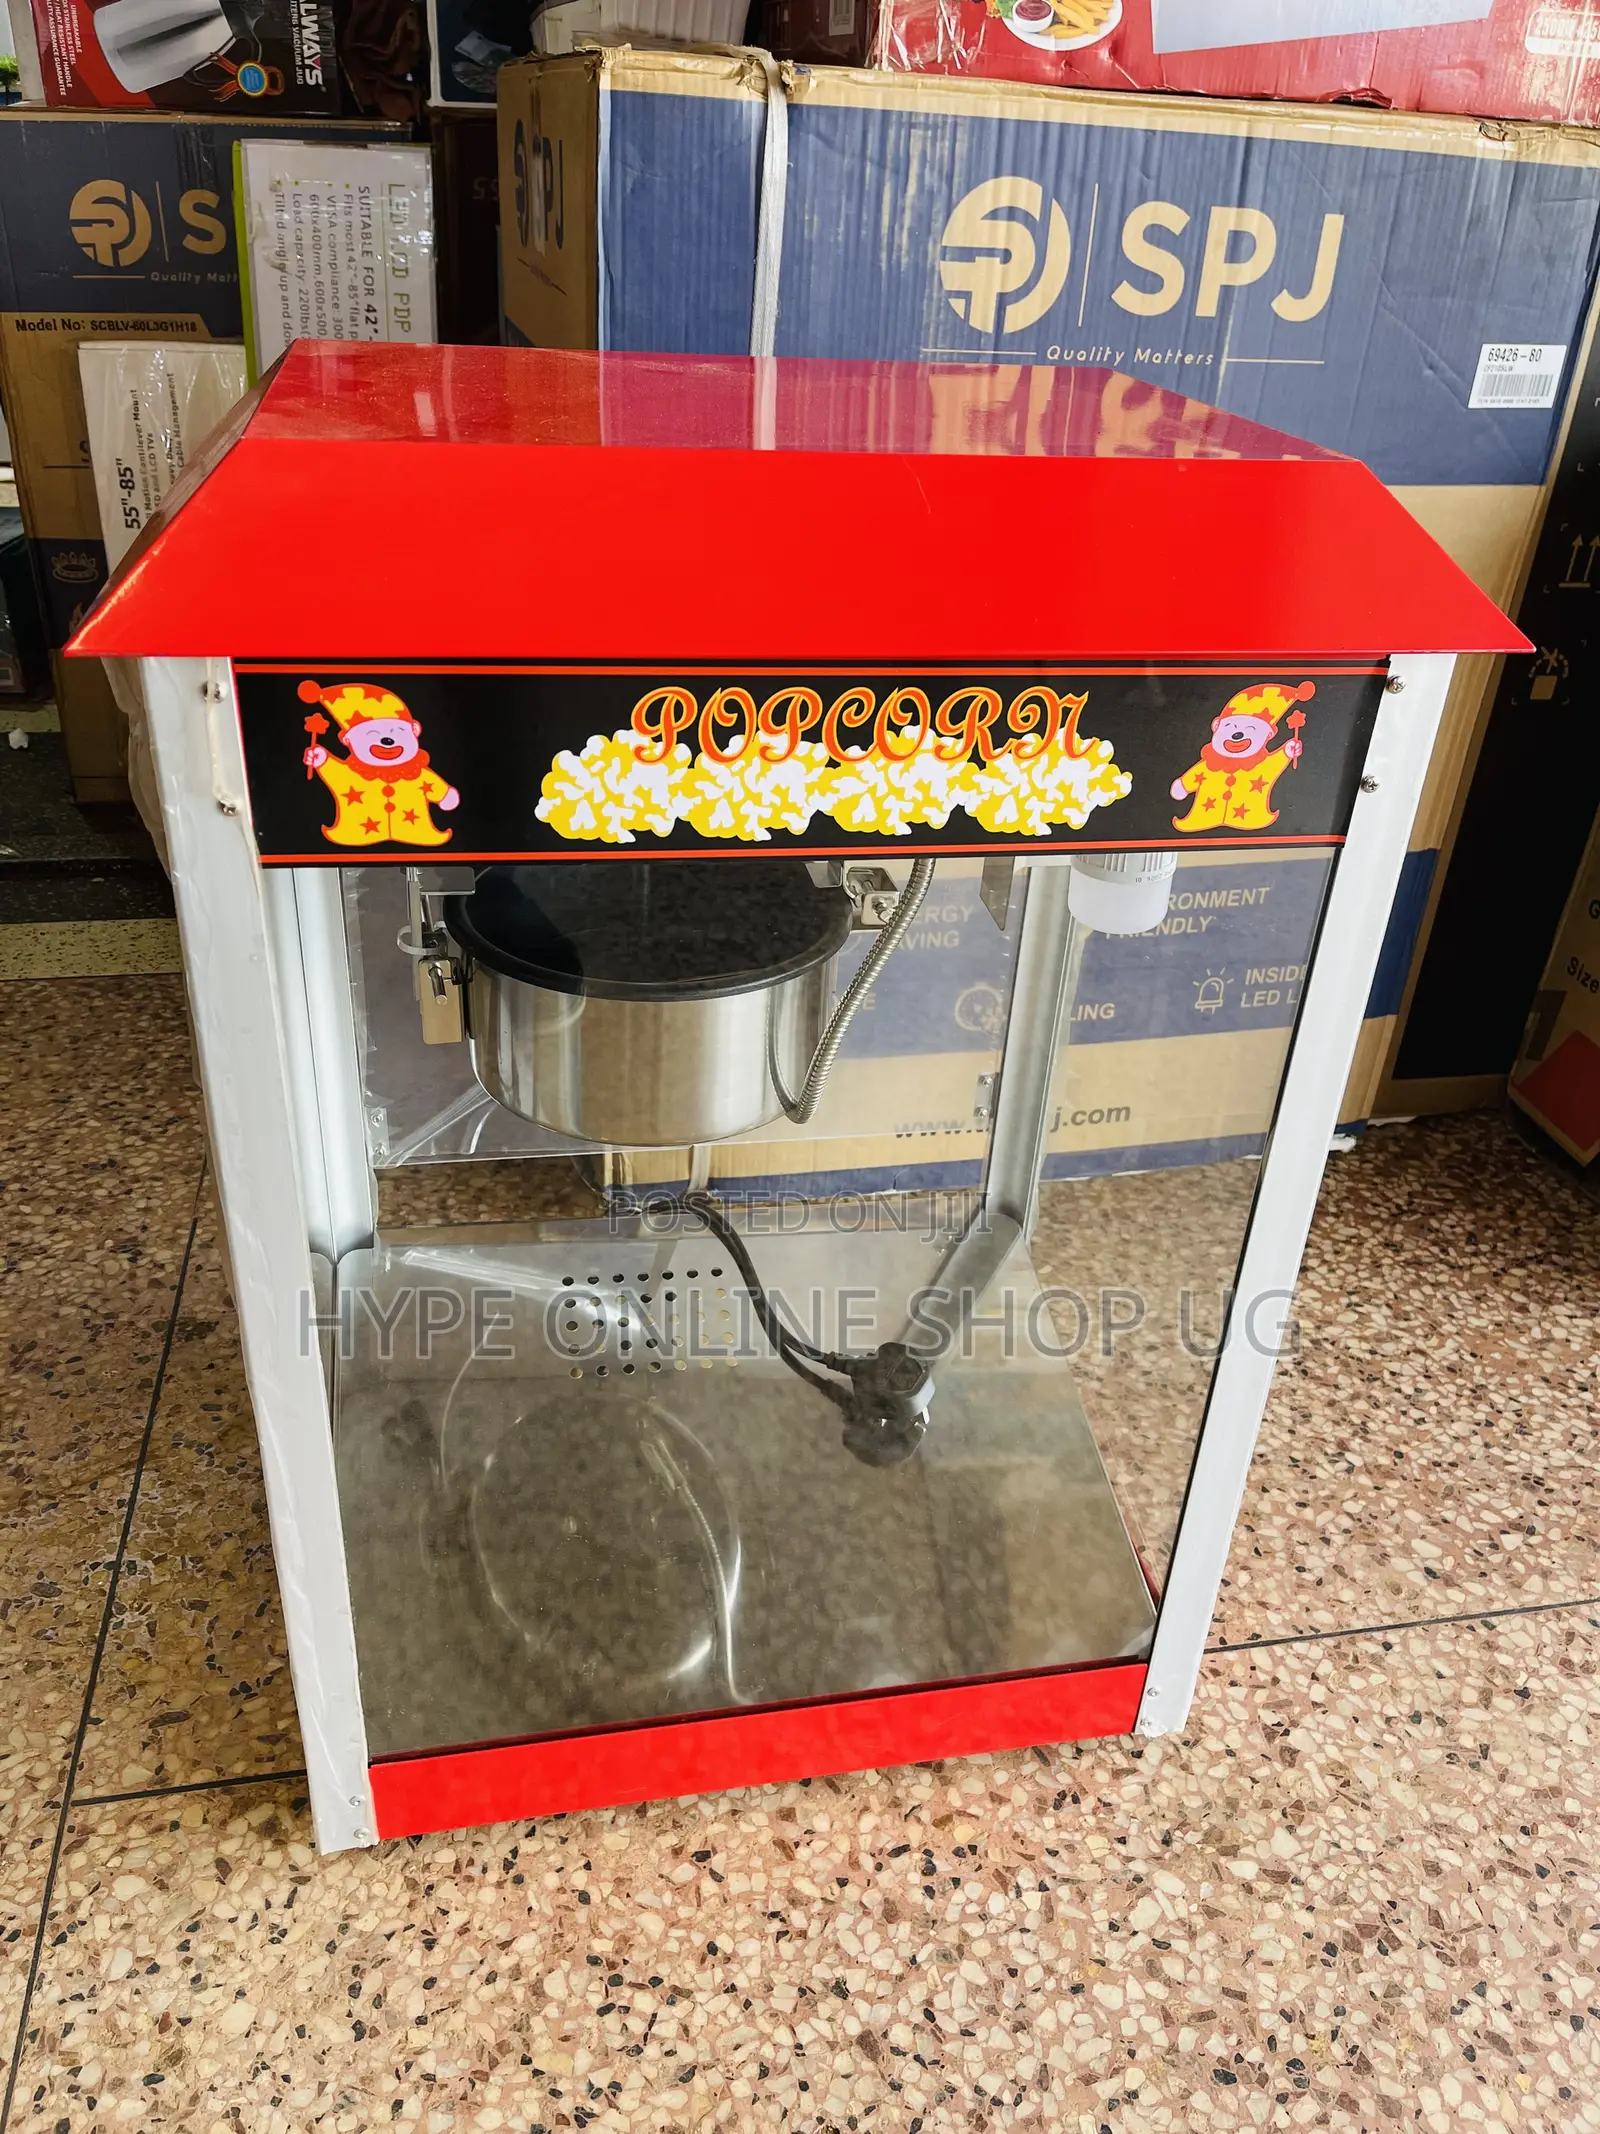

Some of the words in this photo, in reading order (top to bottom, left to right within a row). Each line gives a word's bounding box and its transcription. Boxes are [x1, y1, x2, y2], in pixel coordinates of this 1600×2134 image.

[55, 6, 63, 24] HEAT
[71, 4, 82, 54] UNBREAKABLE
[57, 24, 68, 61] RESISTANT
[63, 9, 73, 44] STAINLESS
[68, 45, 77, 65] STEEL
[292, 27, 302, 66] VACUUM
[300, 0, 323, 86] LWAYS
[48, 17, 59, 56] ASSURANCE
[54, 57, 67, 96] GUARANTEE
[62, 61, 73, 88] HANDLE
[295, 67, 304, 85] JUG
[345, 221, 355, 252] most
[358, 186, 373, 258] SUITABLE
[1111, 200, 1345, 322] SPJ
[151, 271, 201, 284] Quality
[363, 266, 375, 297] FOR
[281, 295, 292, 319] and
[393, 293, 411, 333] PDP
[15, 319, 57, 333] Model
[61, 318, 86, 331] No:
[1046, 344, 1126, 365] Quality
[1134, 348, 1215, 366] Matters
[130, 389, 141, 421] Mount
[630, 685, 1102, 764] POPCORN
[1167, 886, 1270, 911] RONMENT
[912, 905, 974, 925] ERGY
[899, 930, 961, 950] AVING
[1240, 989, 1281, 1008] LED
